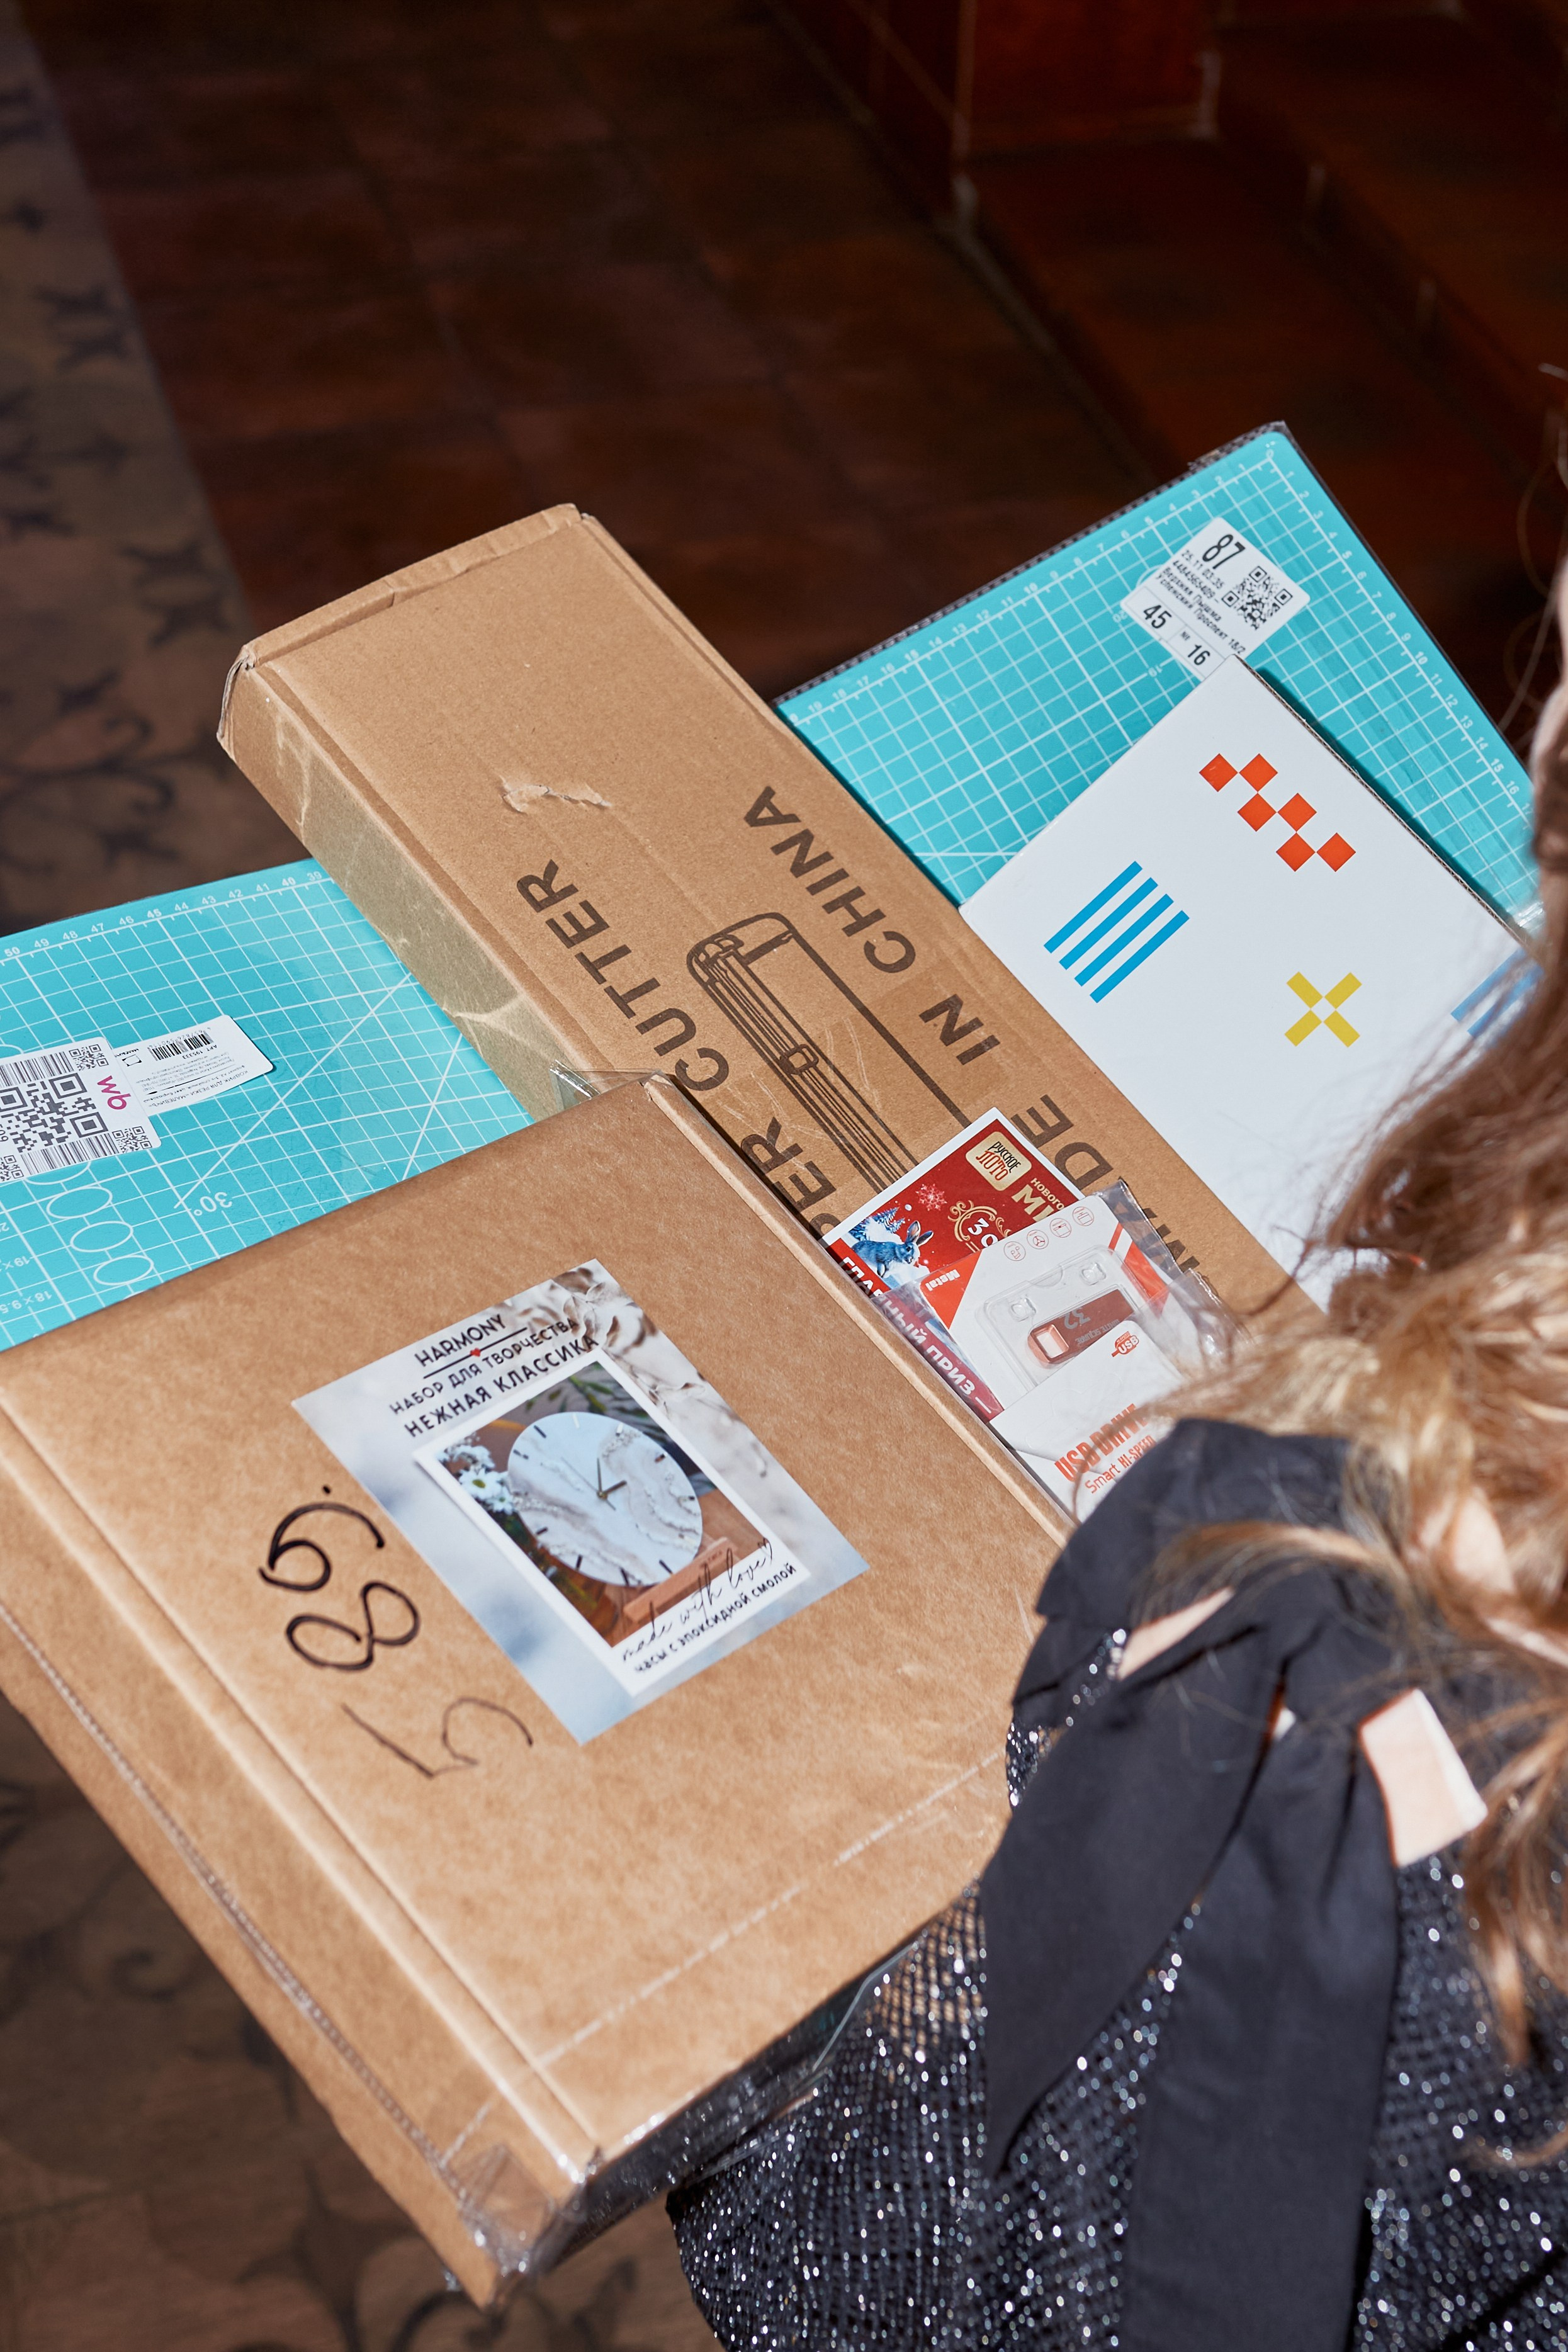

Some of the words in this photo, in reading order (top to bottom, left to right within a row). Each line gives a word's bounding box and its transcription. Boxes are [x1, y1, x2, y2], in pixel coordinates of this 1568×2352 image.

[1202, 534, 1246, 569] 87
[1143, 605, 1172, 629] 45
[1193, 608, 1228, 640] Проспект
[857, 676, 869, 687] 17
[929, 636, 942, 648] 14
[977, 609, 989, 621] 12
[1188, 644, 1210, 665] 16
[1299, 490, 1309, 499] 2
[1313, 511, 1324, 519] 3
[1401, 633, 1411, 642] 9
[1415, 651, 1428, 665] 10
[1431, 673, 1443, 686] 11
[1445, 694, 1458, 708] 12
[1460, 715, 1473, 729] 13
[1476, 737, 1488, 750] 14
[1491, 758, 1504, 772] 15
[1506, 781, 1519, 794] 16
[744, 786, 915, 973] CHINA
[4, 946, 20, 957] 50
[34, 939, 49, 949] 49
[63, 930, 78, 941] 48
[91, 923, 104, 933] 47
[119, 916, 134, 925] 46
[147, 908, 162, 919] 45
[174, 902, 188, 912] 44
[201, 896, 216, 905] 43
[228, 889, 243, 898] 42
[256, 883, 270, 892] 41
[282, 877, 296, 886] 40
[307, 871, 322, 881] 39
[517, 859, 729, 1091] CUTTER
[919, 994, 1000, 1065] IN
[97, 1075, 131, 1110] wb
[976, 1151, 1008, 1181] ЛОТО
[987, 1141, 1021, 1173] РУССКОЕ
[194, 1192, 232, 1216] 30°
[14, 1256, 30, 1267] 19
[35, 1291, 52, 1302] 18
[925, 1269, 961, 1291] Metal
[1064, 1308, 1091, 1330] 32
[414, 1314, 505, 1367] HARMONY
[1118, 1335, 1139, 1354] USB
[389, 1381, 444, 1415] НАБОР
[448, 1364, 482, 1388] ДЛЯ
[482, 1318, 578, 1369] ТВОРЧЕСТВА
[926, 1345, 976, 1396] ПРИЗ
[404, 1386, 492, 1437] НЕЖНАЯ
[494, 1335, 599, 1393] КЛАССИКА
[1054, 1442, 1101, 1482] USB
[1085, 1464, 1120, 1494] Smart
[623, 1602, 672, 1661] made
[680, 1562, 723, 1623] with
[727, 1548, 767, 1588] love
